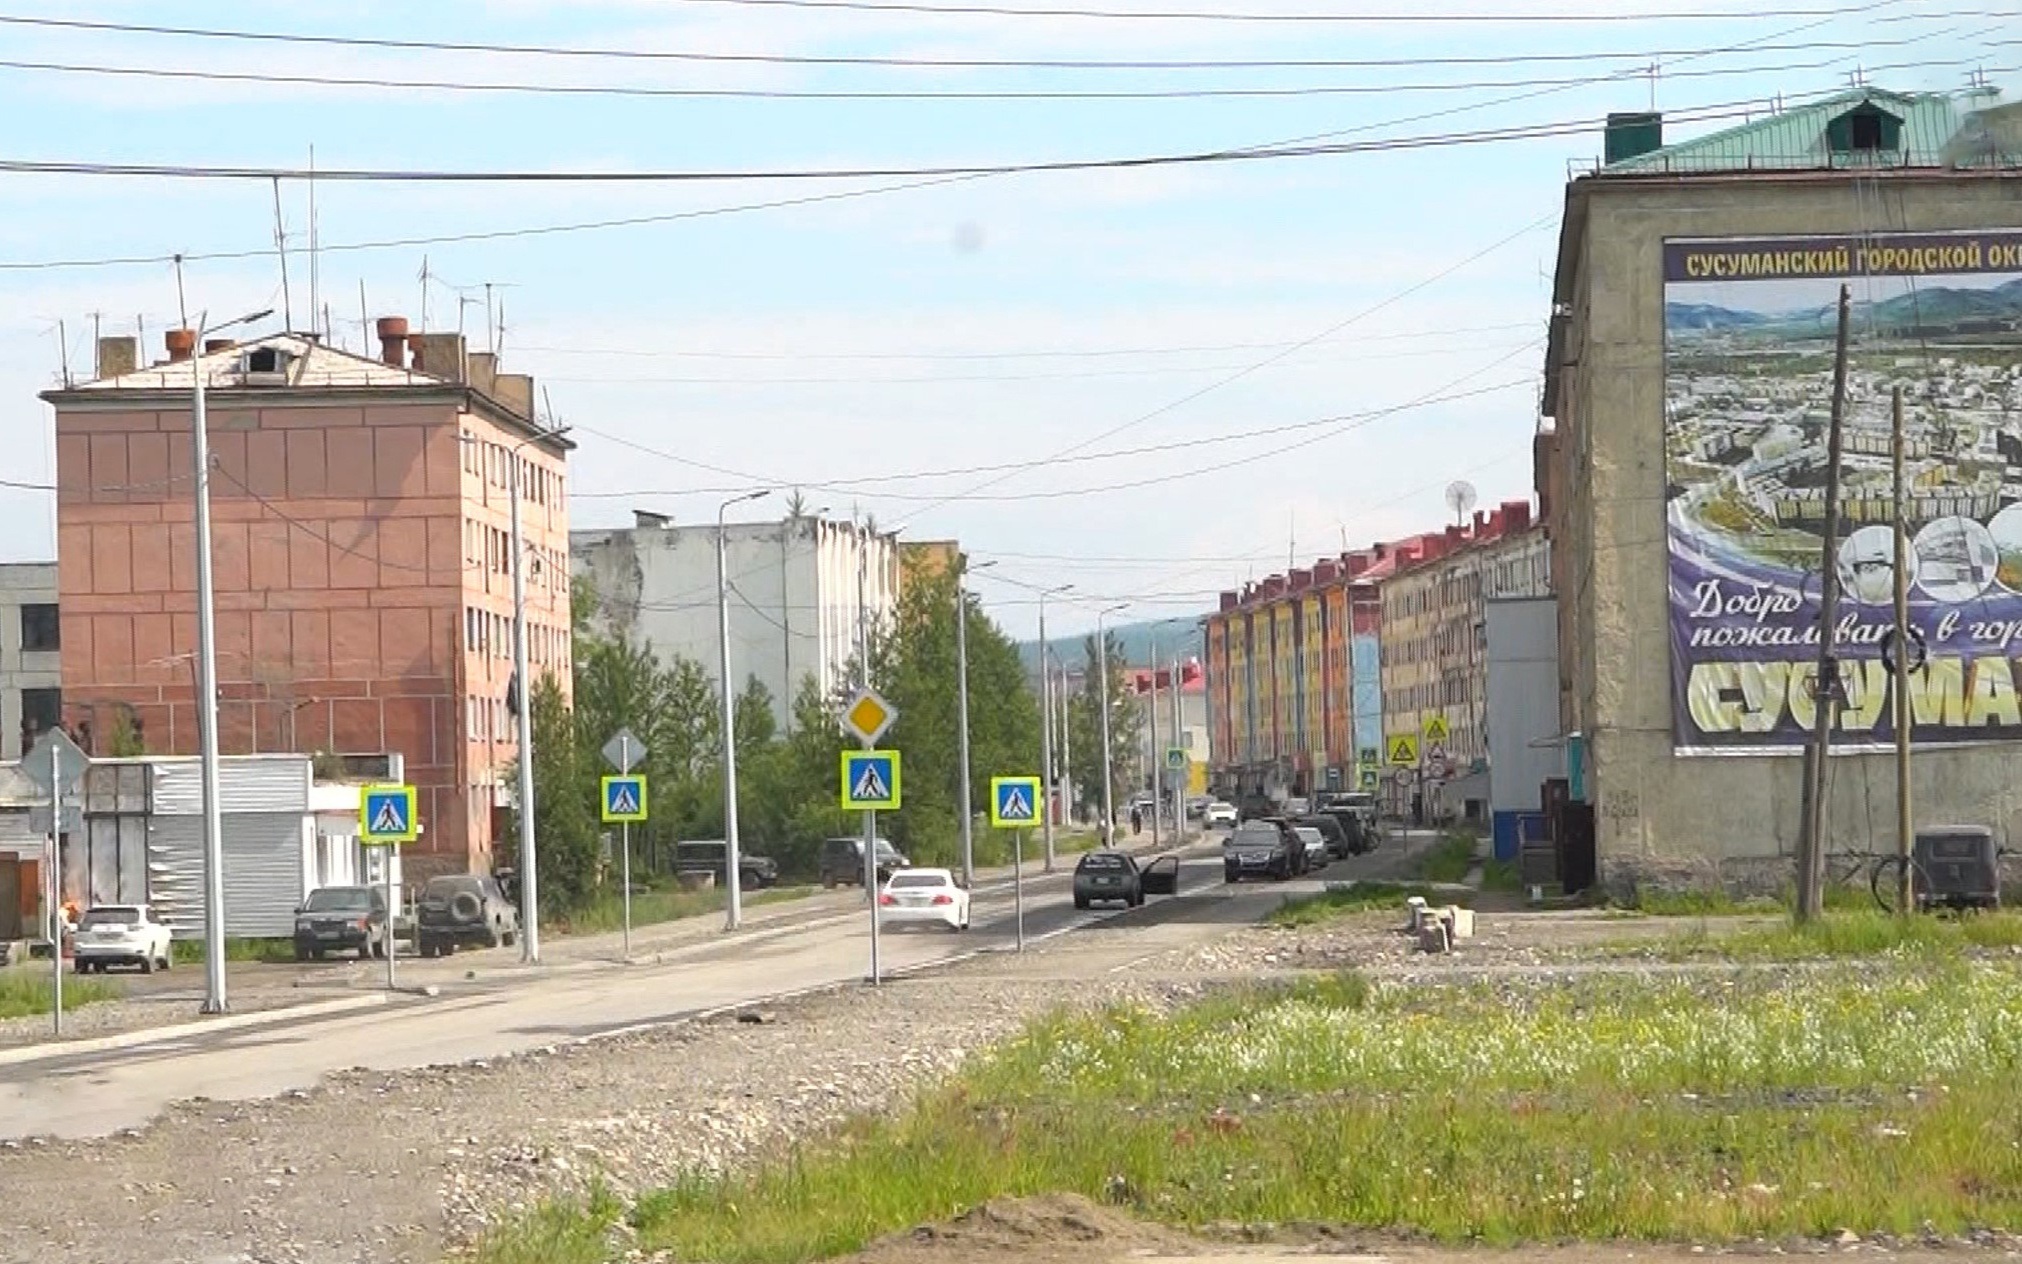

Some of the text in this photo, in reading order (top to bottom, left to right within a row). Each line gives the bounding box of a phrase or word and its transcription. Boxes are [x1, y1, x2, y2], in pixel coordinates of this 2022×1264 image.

[1687, 241, 2022, 276] СУСУМАНСКИЙ ГОРОДСКОЙ ОК
[1690, 580, 1802, 622] Добро
[1937, 611, 1961, 641] в
[1688, 656, 2022, 732] СУСУМА
